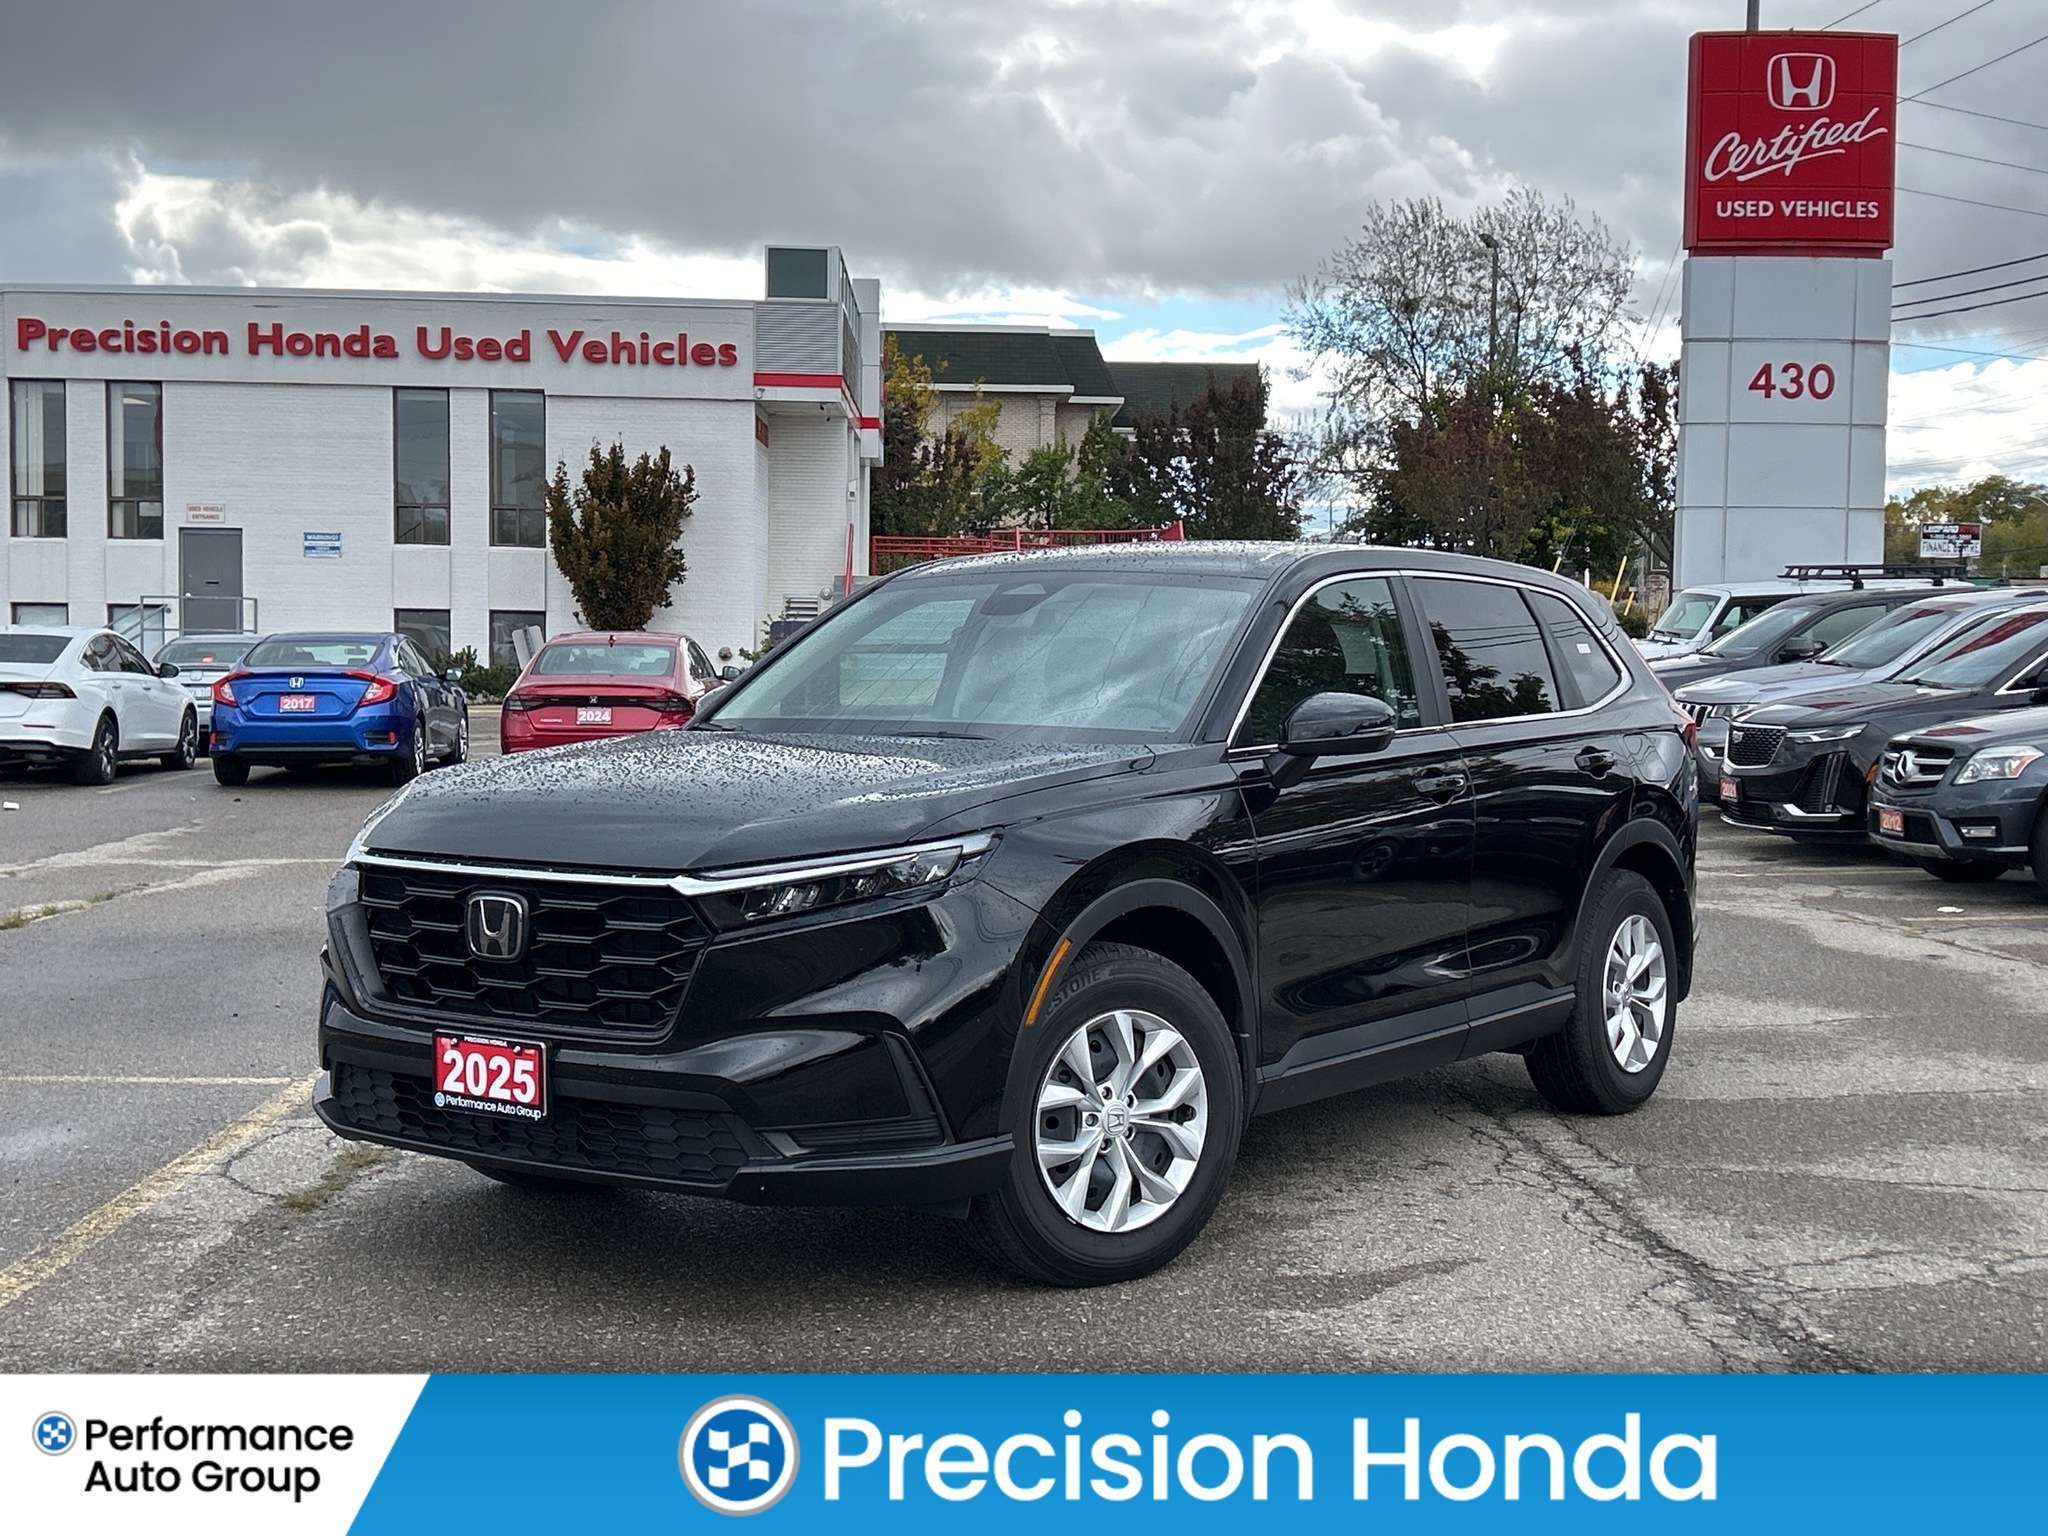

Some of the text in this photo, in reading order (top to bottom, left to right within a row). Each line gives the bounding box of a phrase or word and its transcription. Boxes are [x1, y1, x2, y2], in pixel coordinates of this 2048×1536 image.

[1704, 107, 1888, 181] Certified
[1716, 200, 1879, 219] USED VEHICLES
[17, 318, 737, 366] Precision Honda Used Vehicles
[1748, 362, 1835, 400] 430
[1922, 541, 1951, 553] FINANCE
[283, 698, 312, 709] 2017
[579, 711, 609, 721] 2024
[1882, 813, 1902, 831] 2012
[443, 1049, 536, 1104] 2025
[446, 1094, 541, 1121] Performance Auto Group
